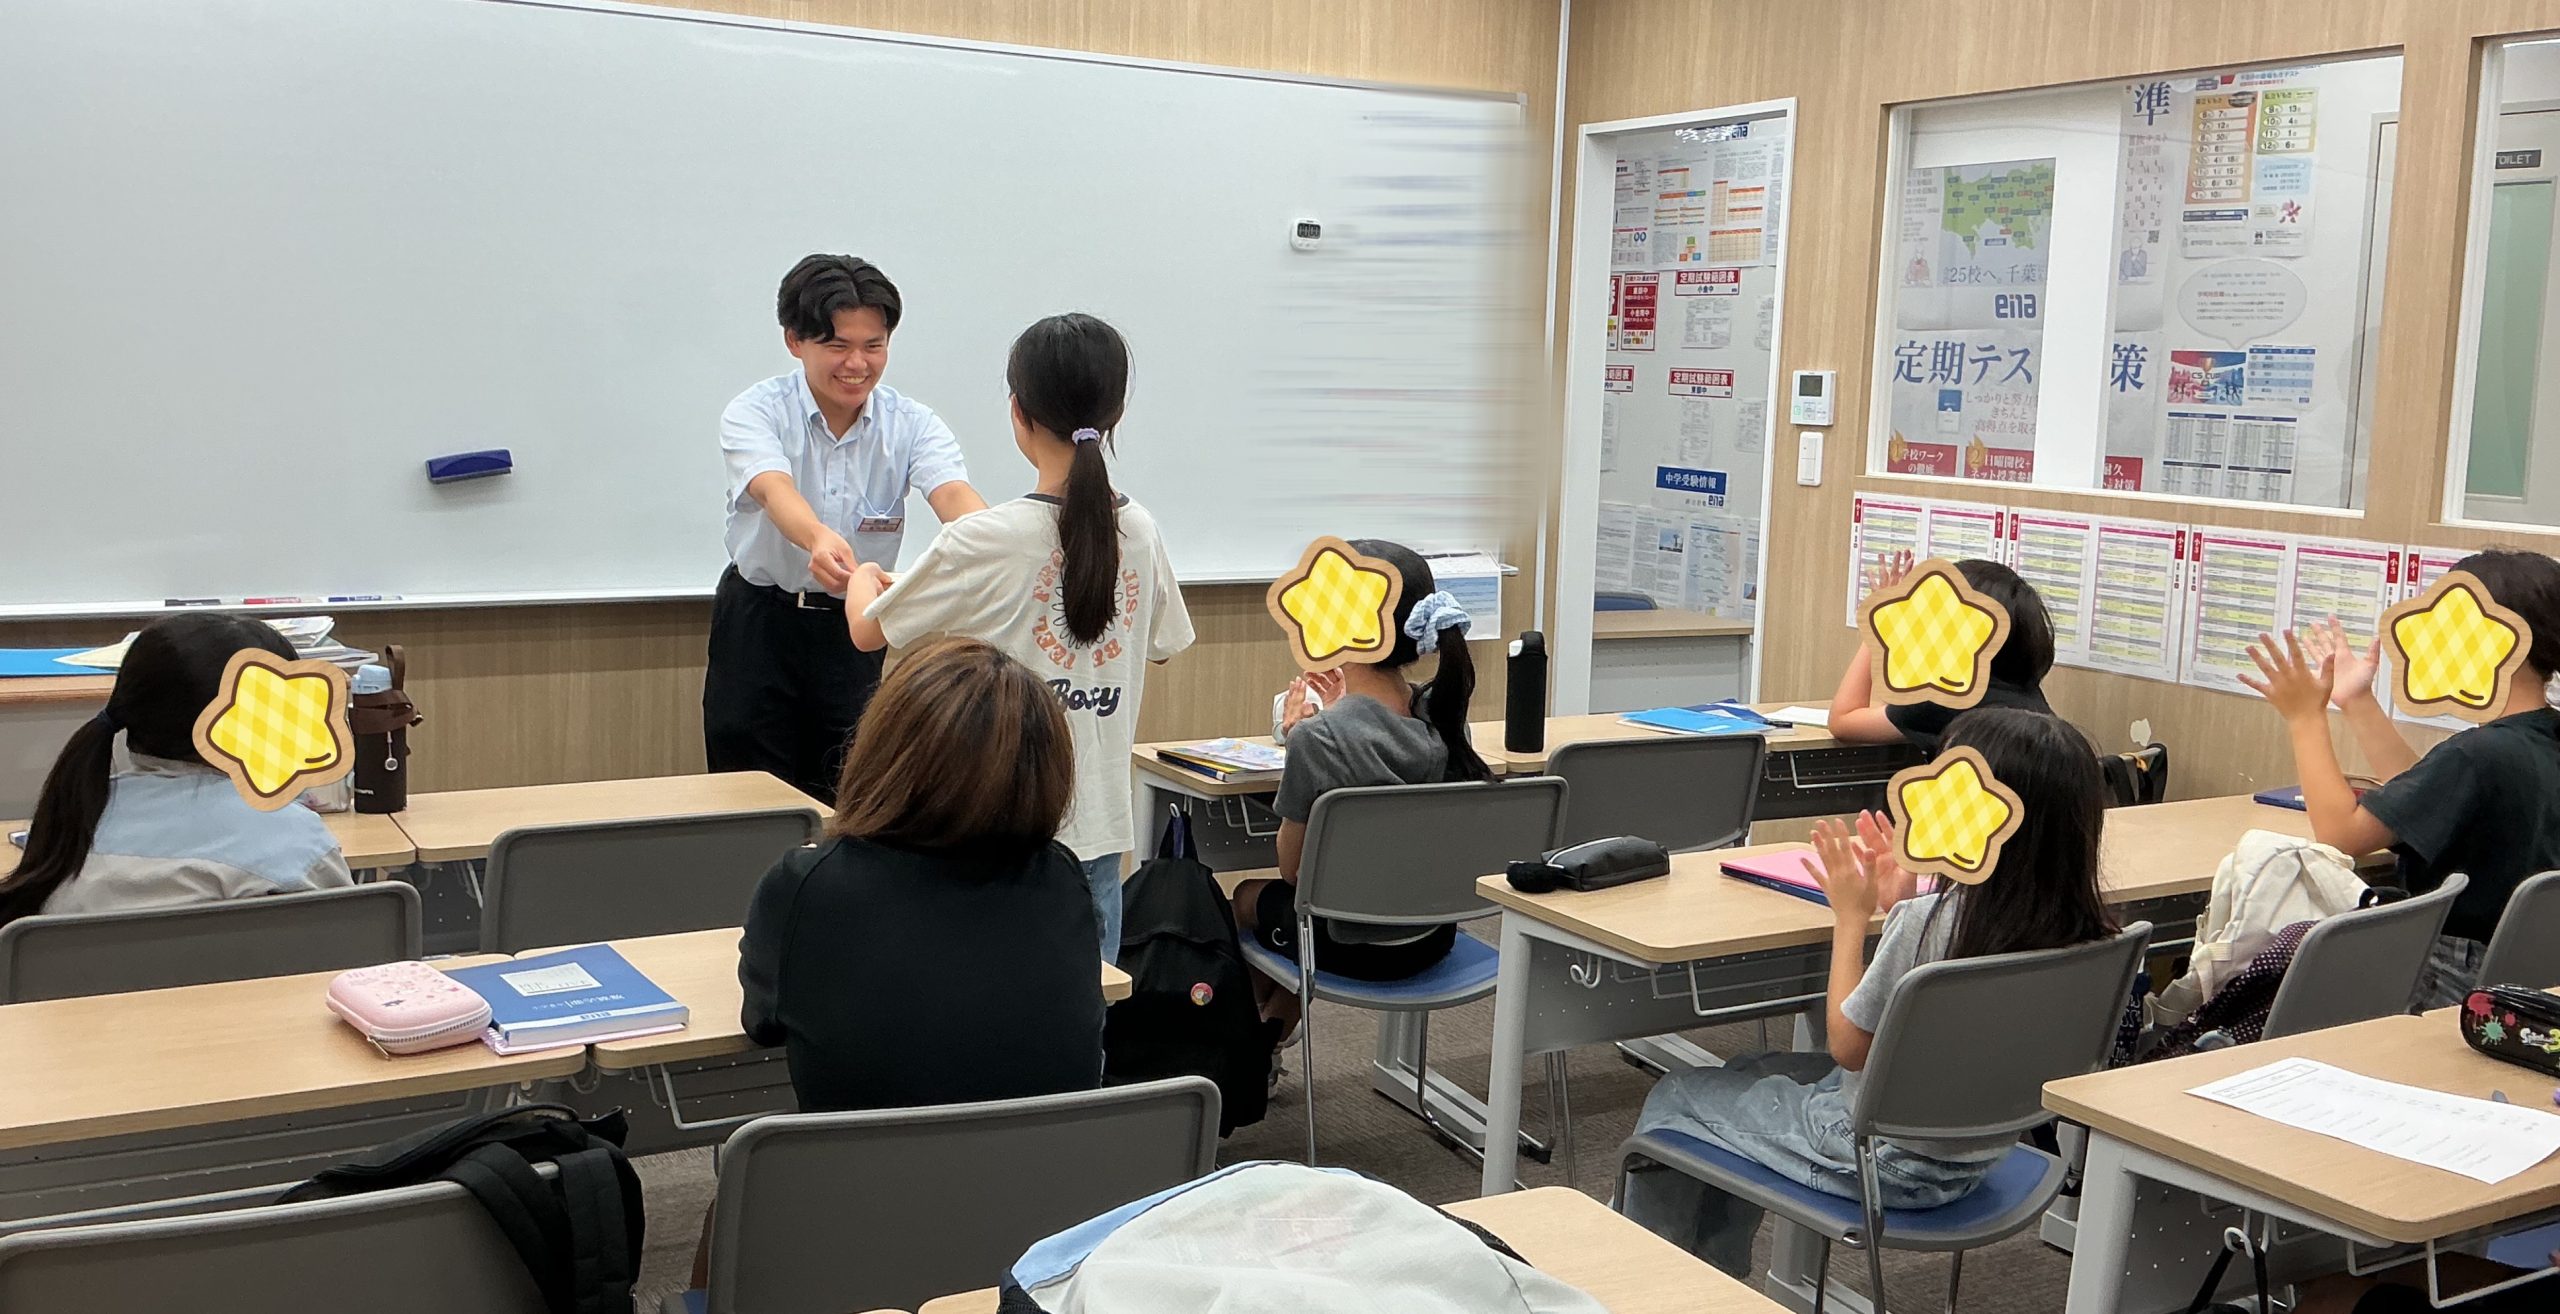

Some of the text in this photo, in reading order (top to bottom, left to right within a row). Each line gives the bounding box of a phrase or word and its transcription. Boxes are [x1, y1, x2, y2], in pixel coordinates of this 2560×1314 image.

[2133, 81, 2171, 126] 準
[1893, 340, 2034, 385] 定期テス
[1665, 471, 1717, 489] 中学受験情報
